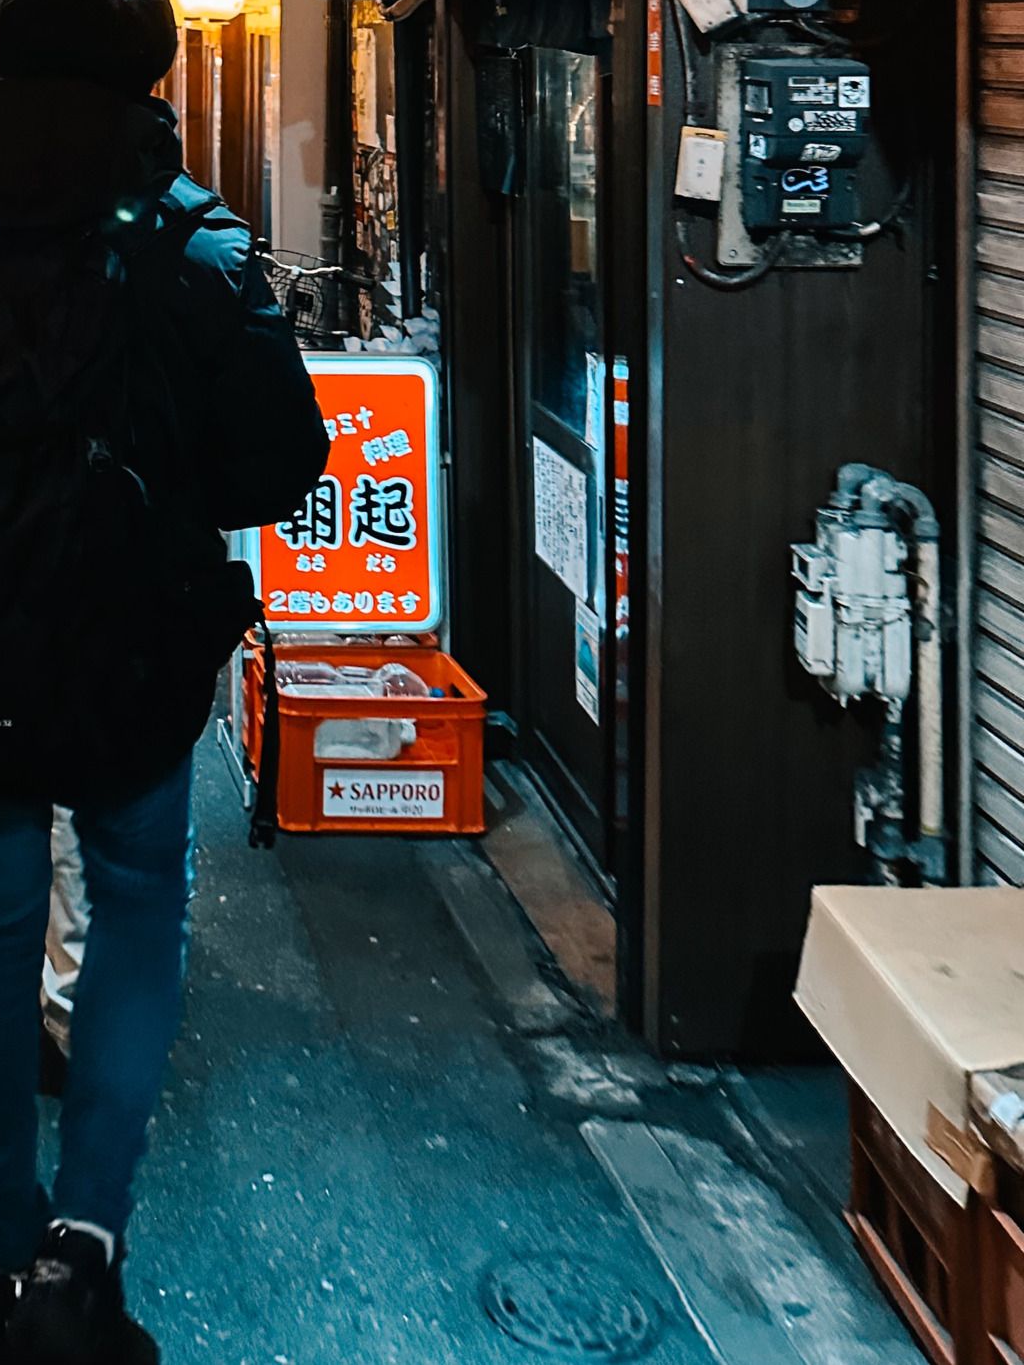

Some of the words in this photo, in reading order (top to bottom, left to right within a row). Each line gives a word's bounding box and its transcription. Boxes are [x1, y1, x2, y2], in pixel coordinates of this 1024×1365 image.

[361, 429, 413, 467] 料理
[296, 553, 327, 572] あさ
[365, 552, 397, 573] だち
[268, 590, 421, 614] 2階もあります
[349, 782, 441, 802] SAPPORO
